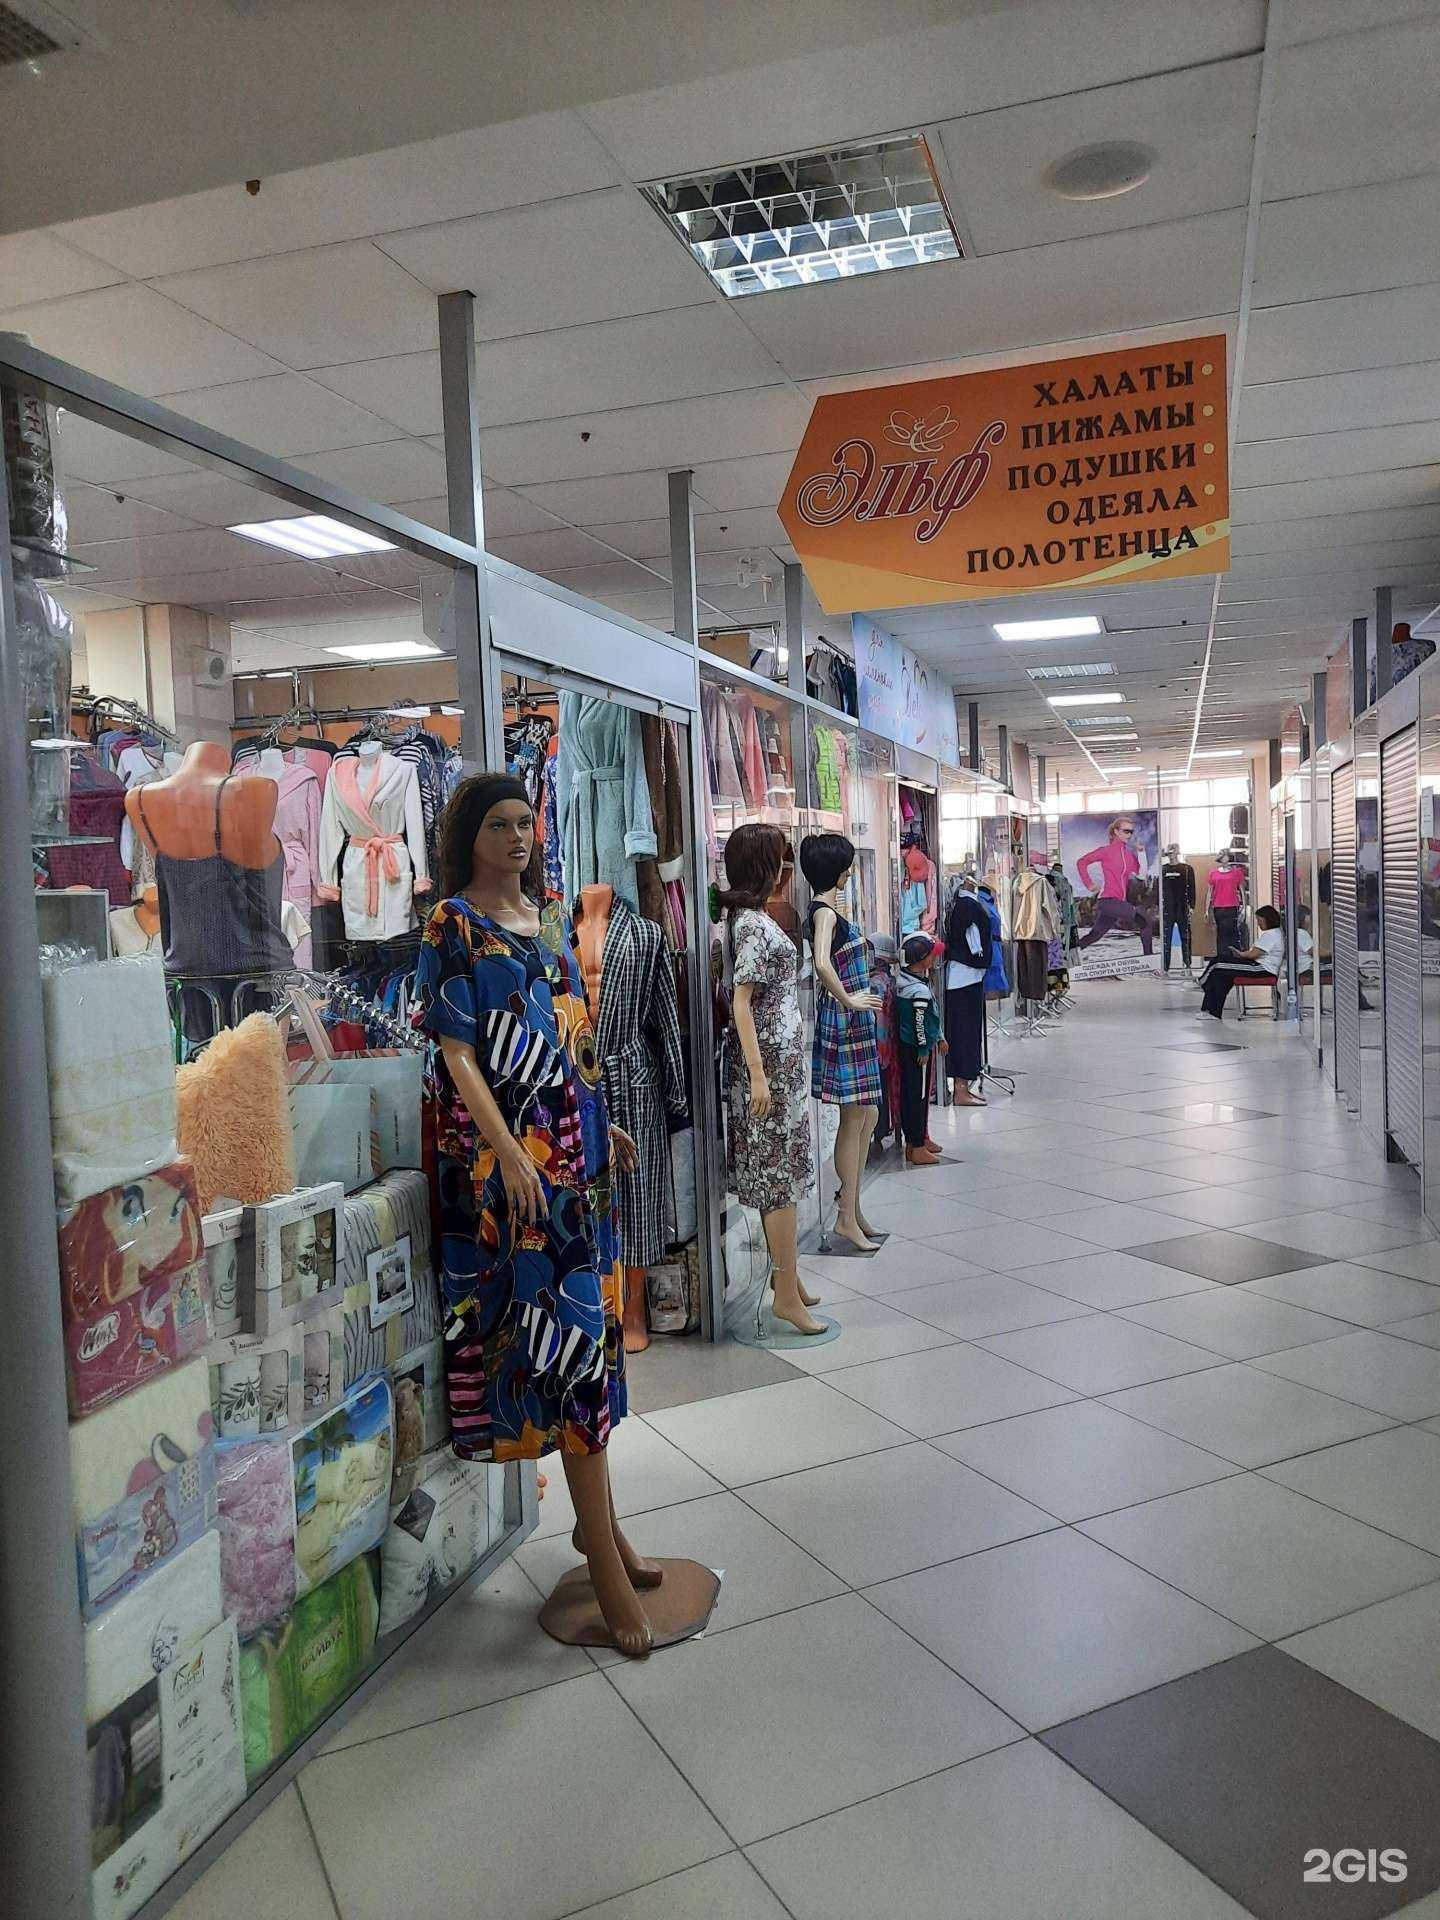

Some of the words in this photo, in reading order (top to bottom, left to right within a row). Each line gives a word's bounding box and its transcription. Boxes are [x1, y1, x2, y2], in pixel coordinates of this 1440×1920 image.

[1033, 361, 1194, 407] ХАЛАТЫ
[1021, 402, 1195, 449] ПИЖАМЫ
[797, 420, 1007, 544] Эльф
[1008, 443, 1195, 490] ПОДУШКИ
[1046, 484, 1198, 527] ОДЕЯЛА
[967, 525, 1199, 574] ПОЛОТЕНЦА
